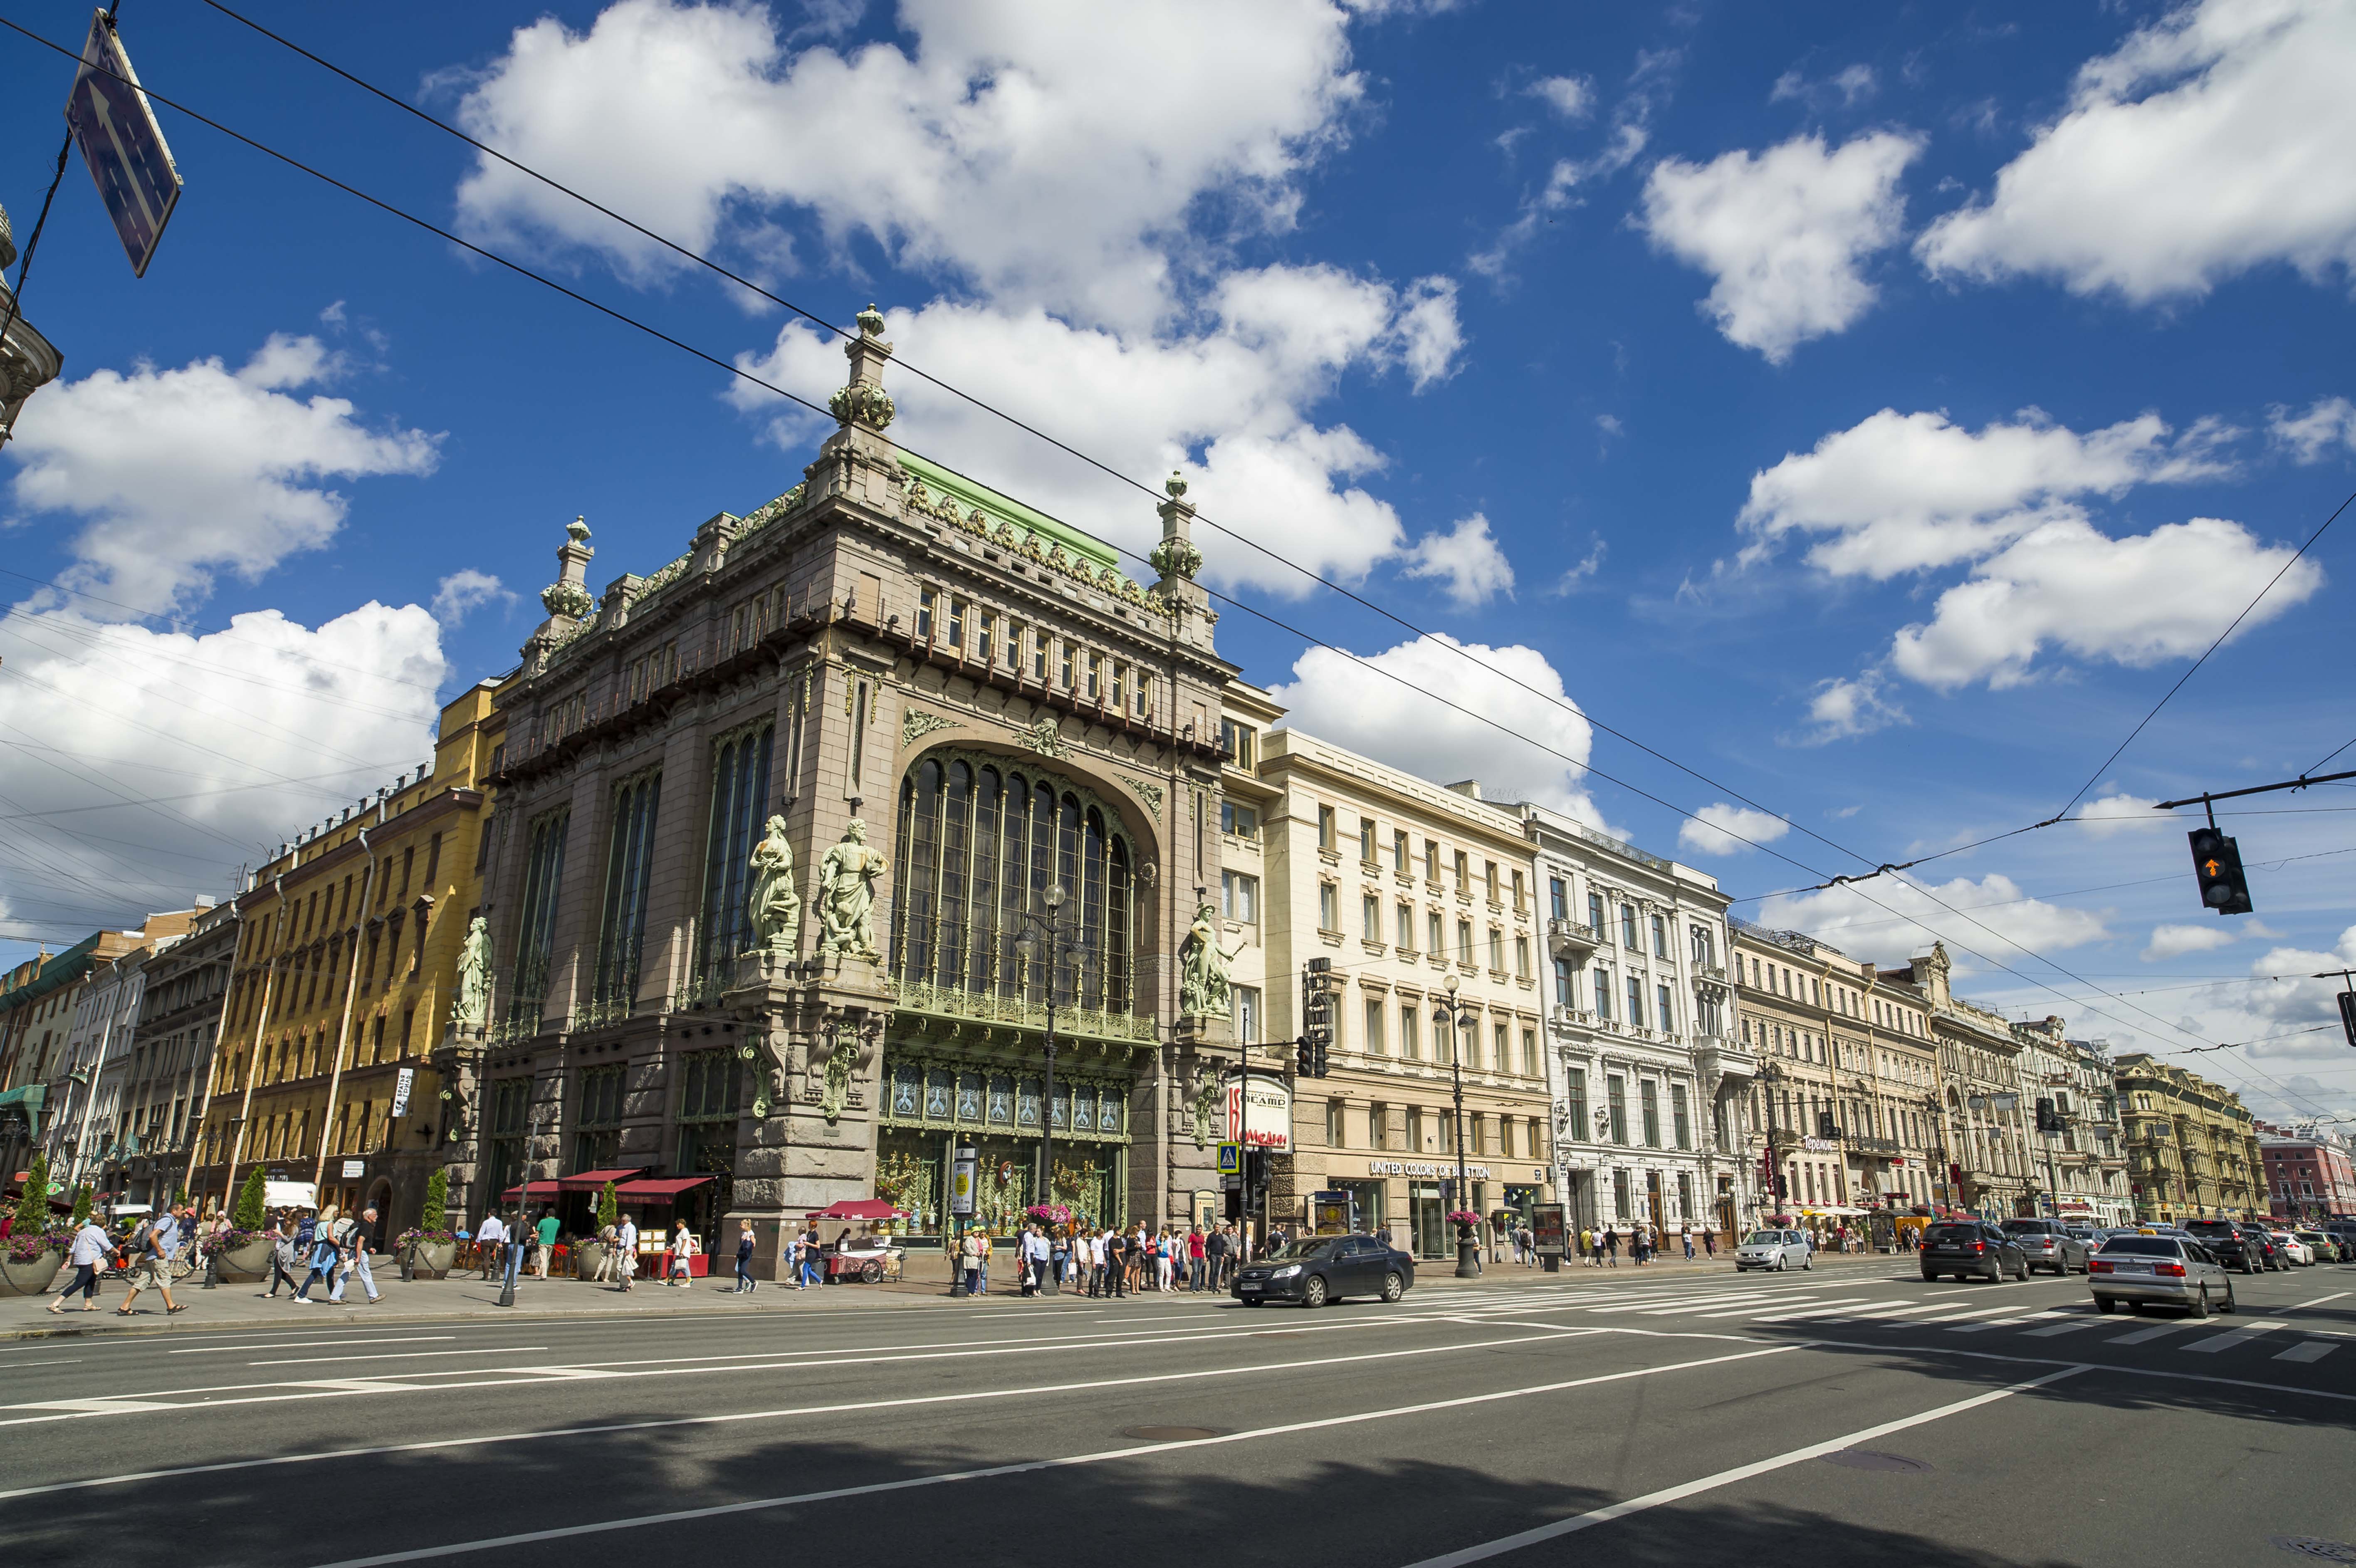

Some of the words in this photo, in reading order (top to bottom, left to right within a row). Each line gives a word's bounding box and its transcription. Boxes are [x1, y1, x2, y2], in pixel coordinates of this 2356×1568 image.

[397, 1075, 405, 1096] БРАТЬЯ
[403, 1075, 411, 1097] ГРИЛЬ
[1803, 1134, 1832, 1154] Теремок
[1370, 1161, 1401, 1174] UNITED
[1405, 1163, 1435, 1176] COLORS
[1439, 1164, 1451, 1176] OF
